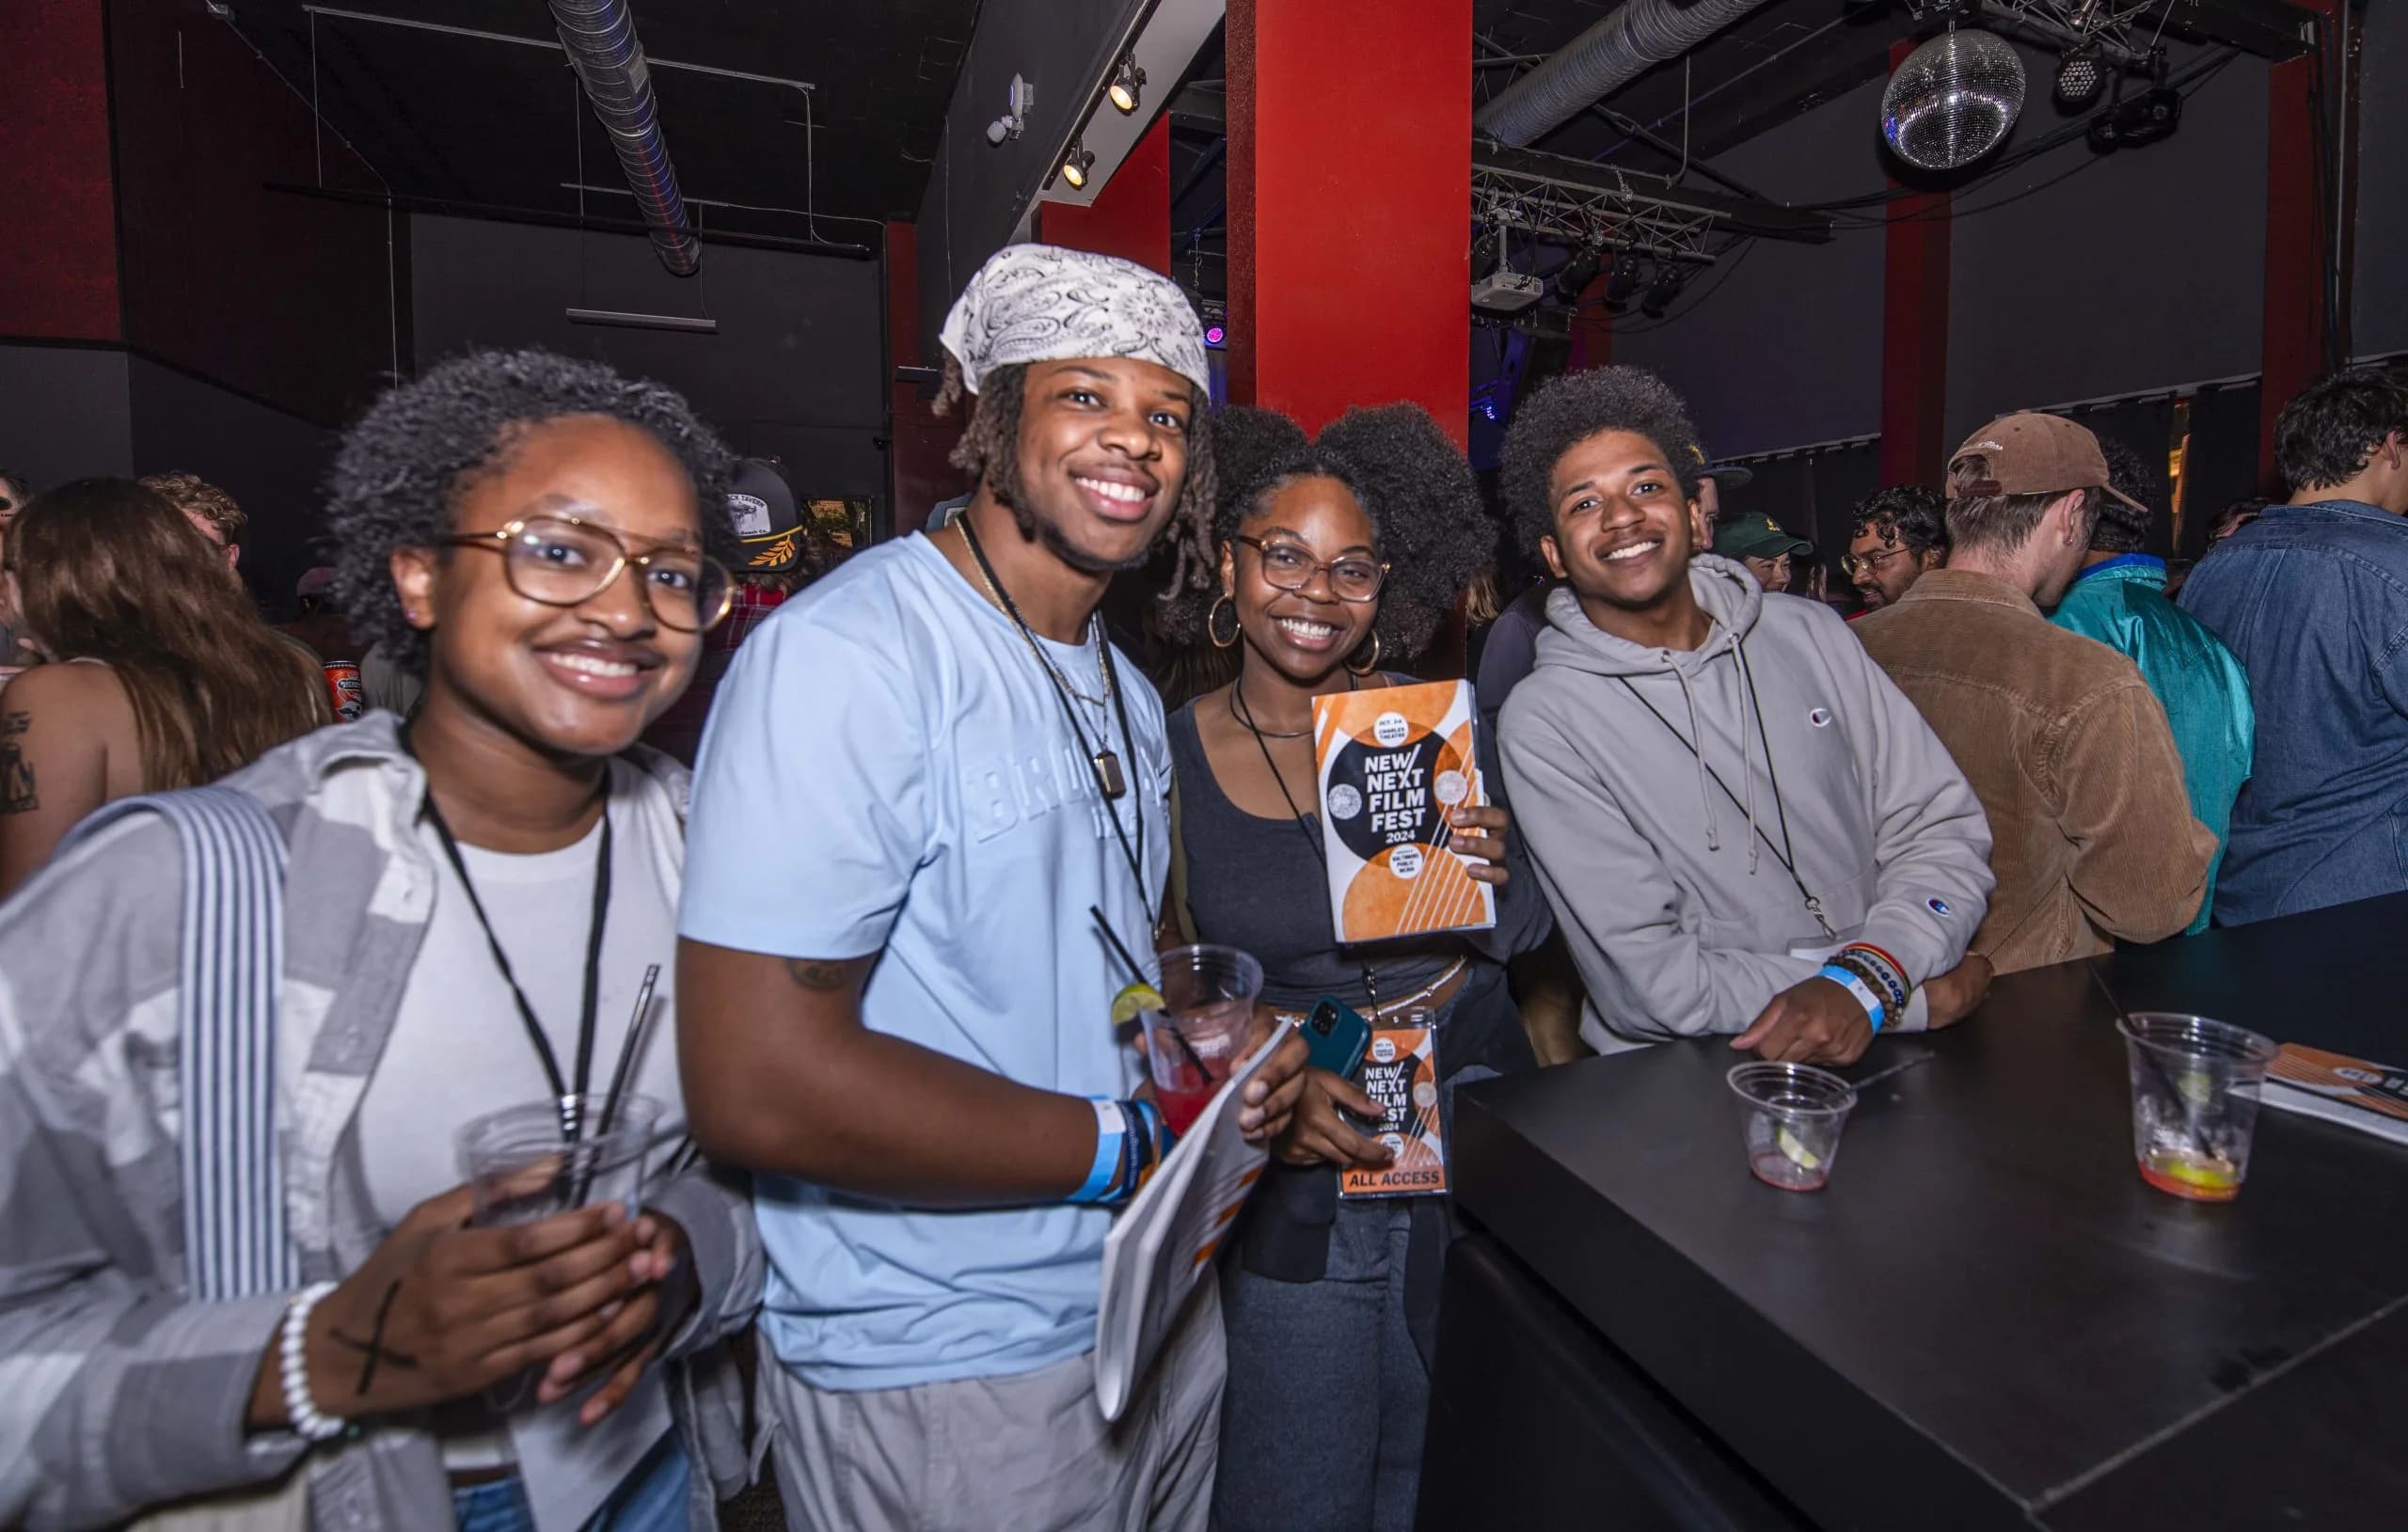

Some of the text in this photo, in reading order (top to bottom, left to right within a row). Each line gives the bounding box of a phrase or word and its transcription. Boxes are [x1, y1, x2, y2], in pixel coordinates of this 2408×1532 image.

[741, 495, 766, 508] TAVERN
[1367, 768, 1424, 794] NEXT
[1369, 788, 1426, 813] FILM
[1370, 808, 1427, 833] FEST
[1386, 829, 1416, 844] 2024
[1366, 1079, 1406, 1095] NEXT
[1349, 1171, 1440, 1187] ALL ACCESS
